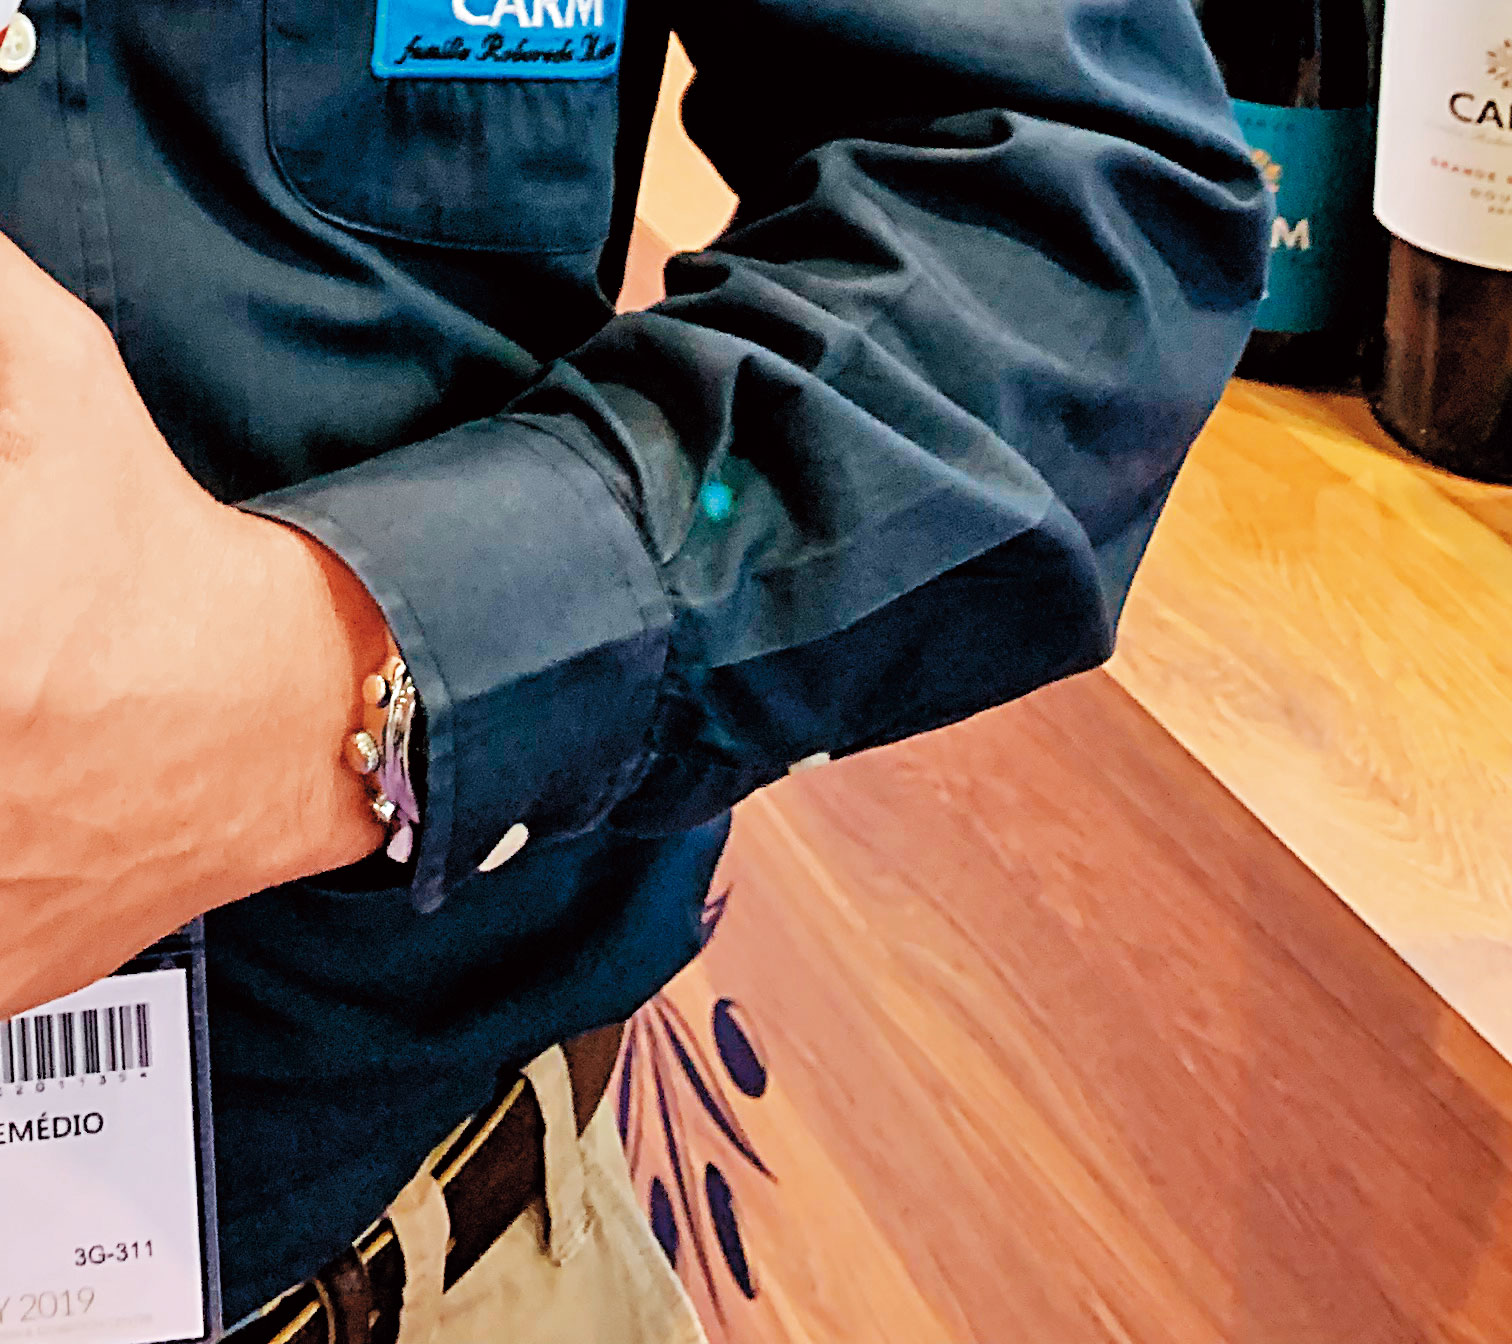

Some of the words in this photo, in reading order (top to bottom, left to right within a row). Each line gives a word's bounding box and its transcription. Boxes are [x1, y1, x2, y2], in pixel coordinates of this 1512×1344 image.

[1448, 91, 1512, 130] CA
[74, 1239, 154, 1267] 3G-311
[19, 1285, 96, 1324] 2019
